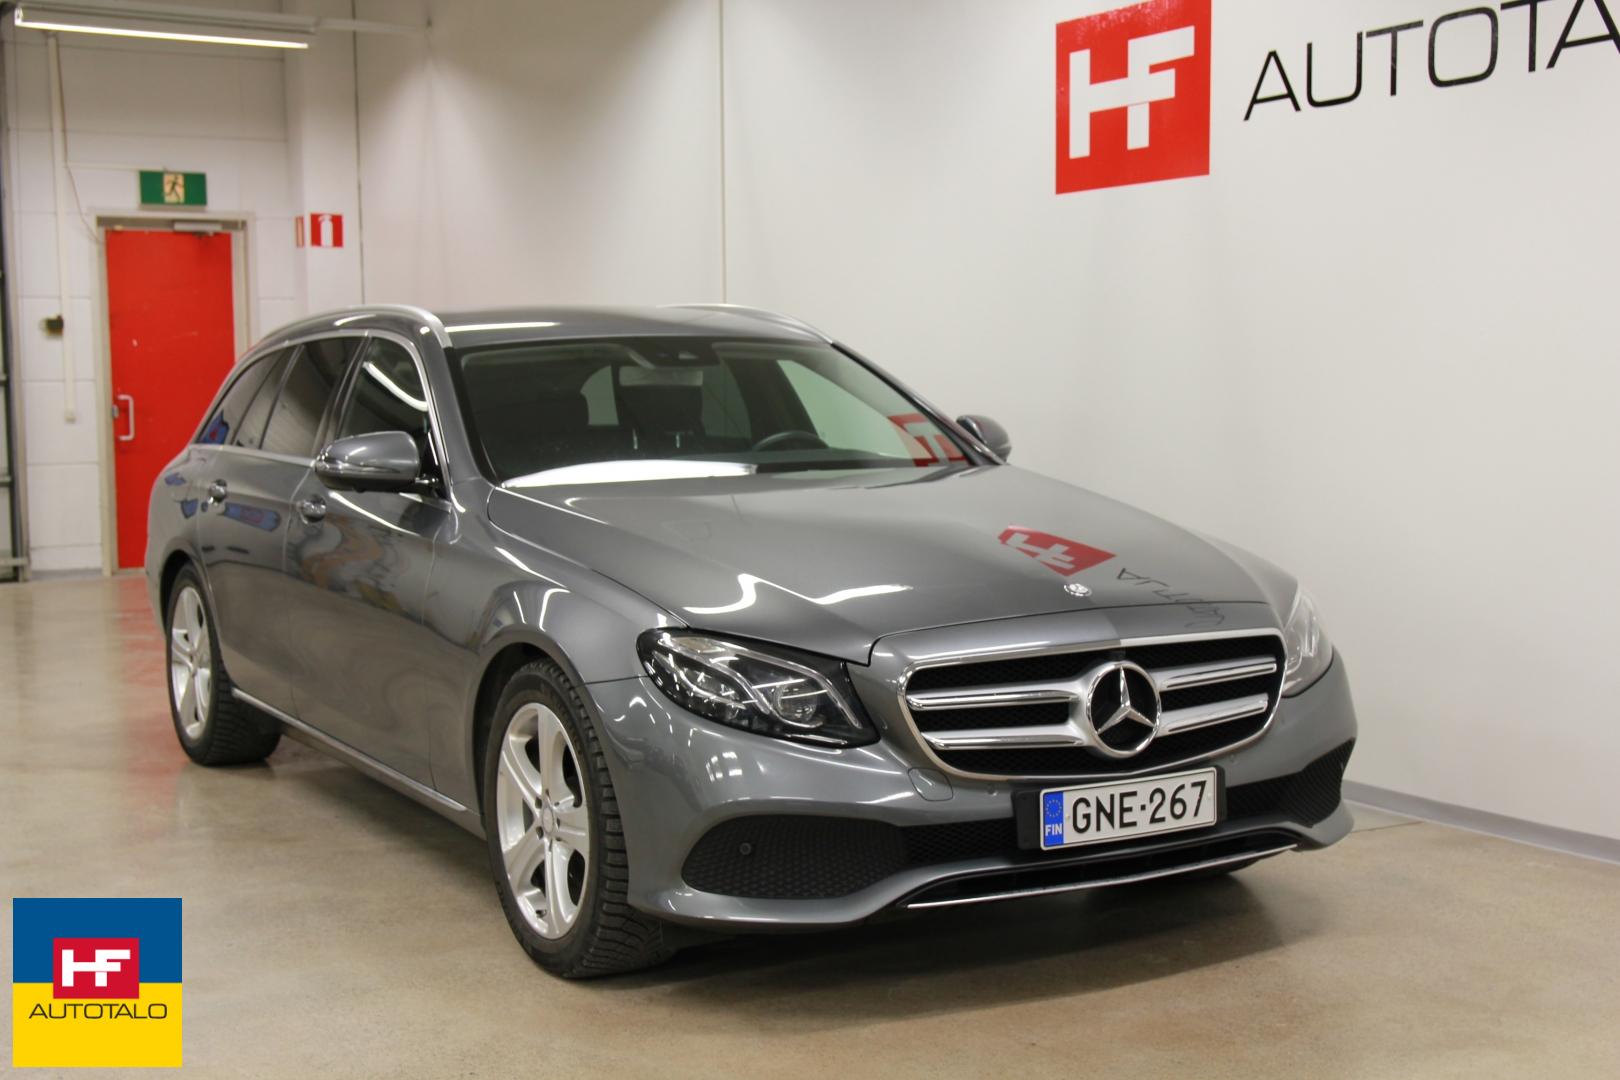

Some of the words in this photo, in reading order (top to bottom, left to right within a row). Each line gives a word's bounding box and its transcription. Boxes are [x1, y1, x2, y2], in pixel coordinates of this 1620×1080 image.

[1069, 25, 1195, 160] HF
[1044, 823, 1063, 837] FIN
[1072, 780, 1207, 834] GNE-267
